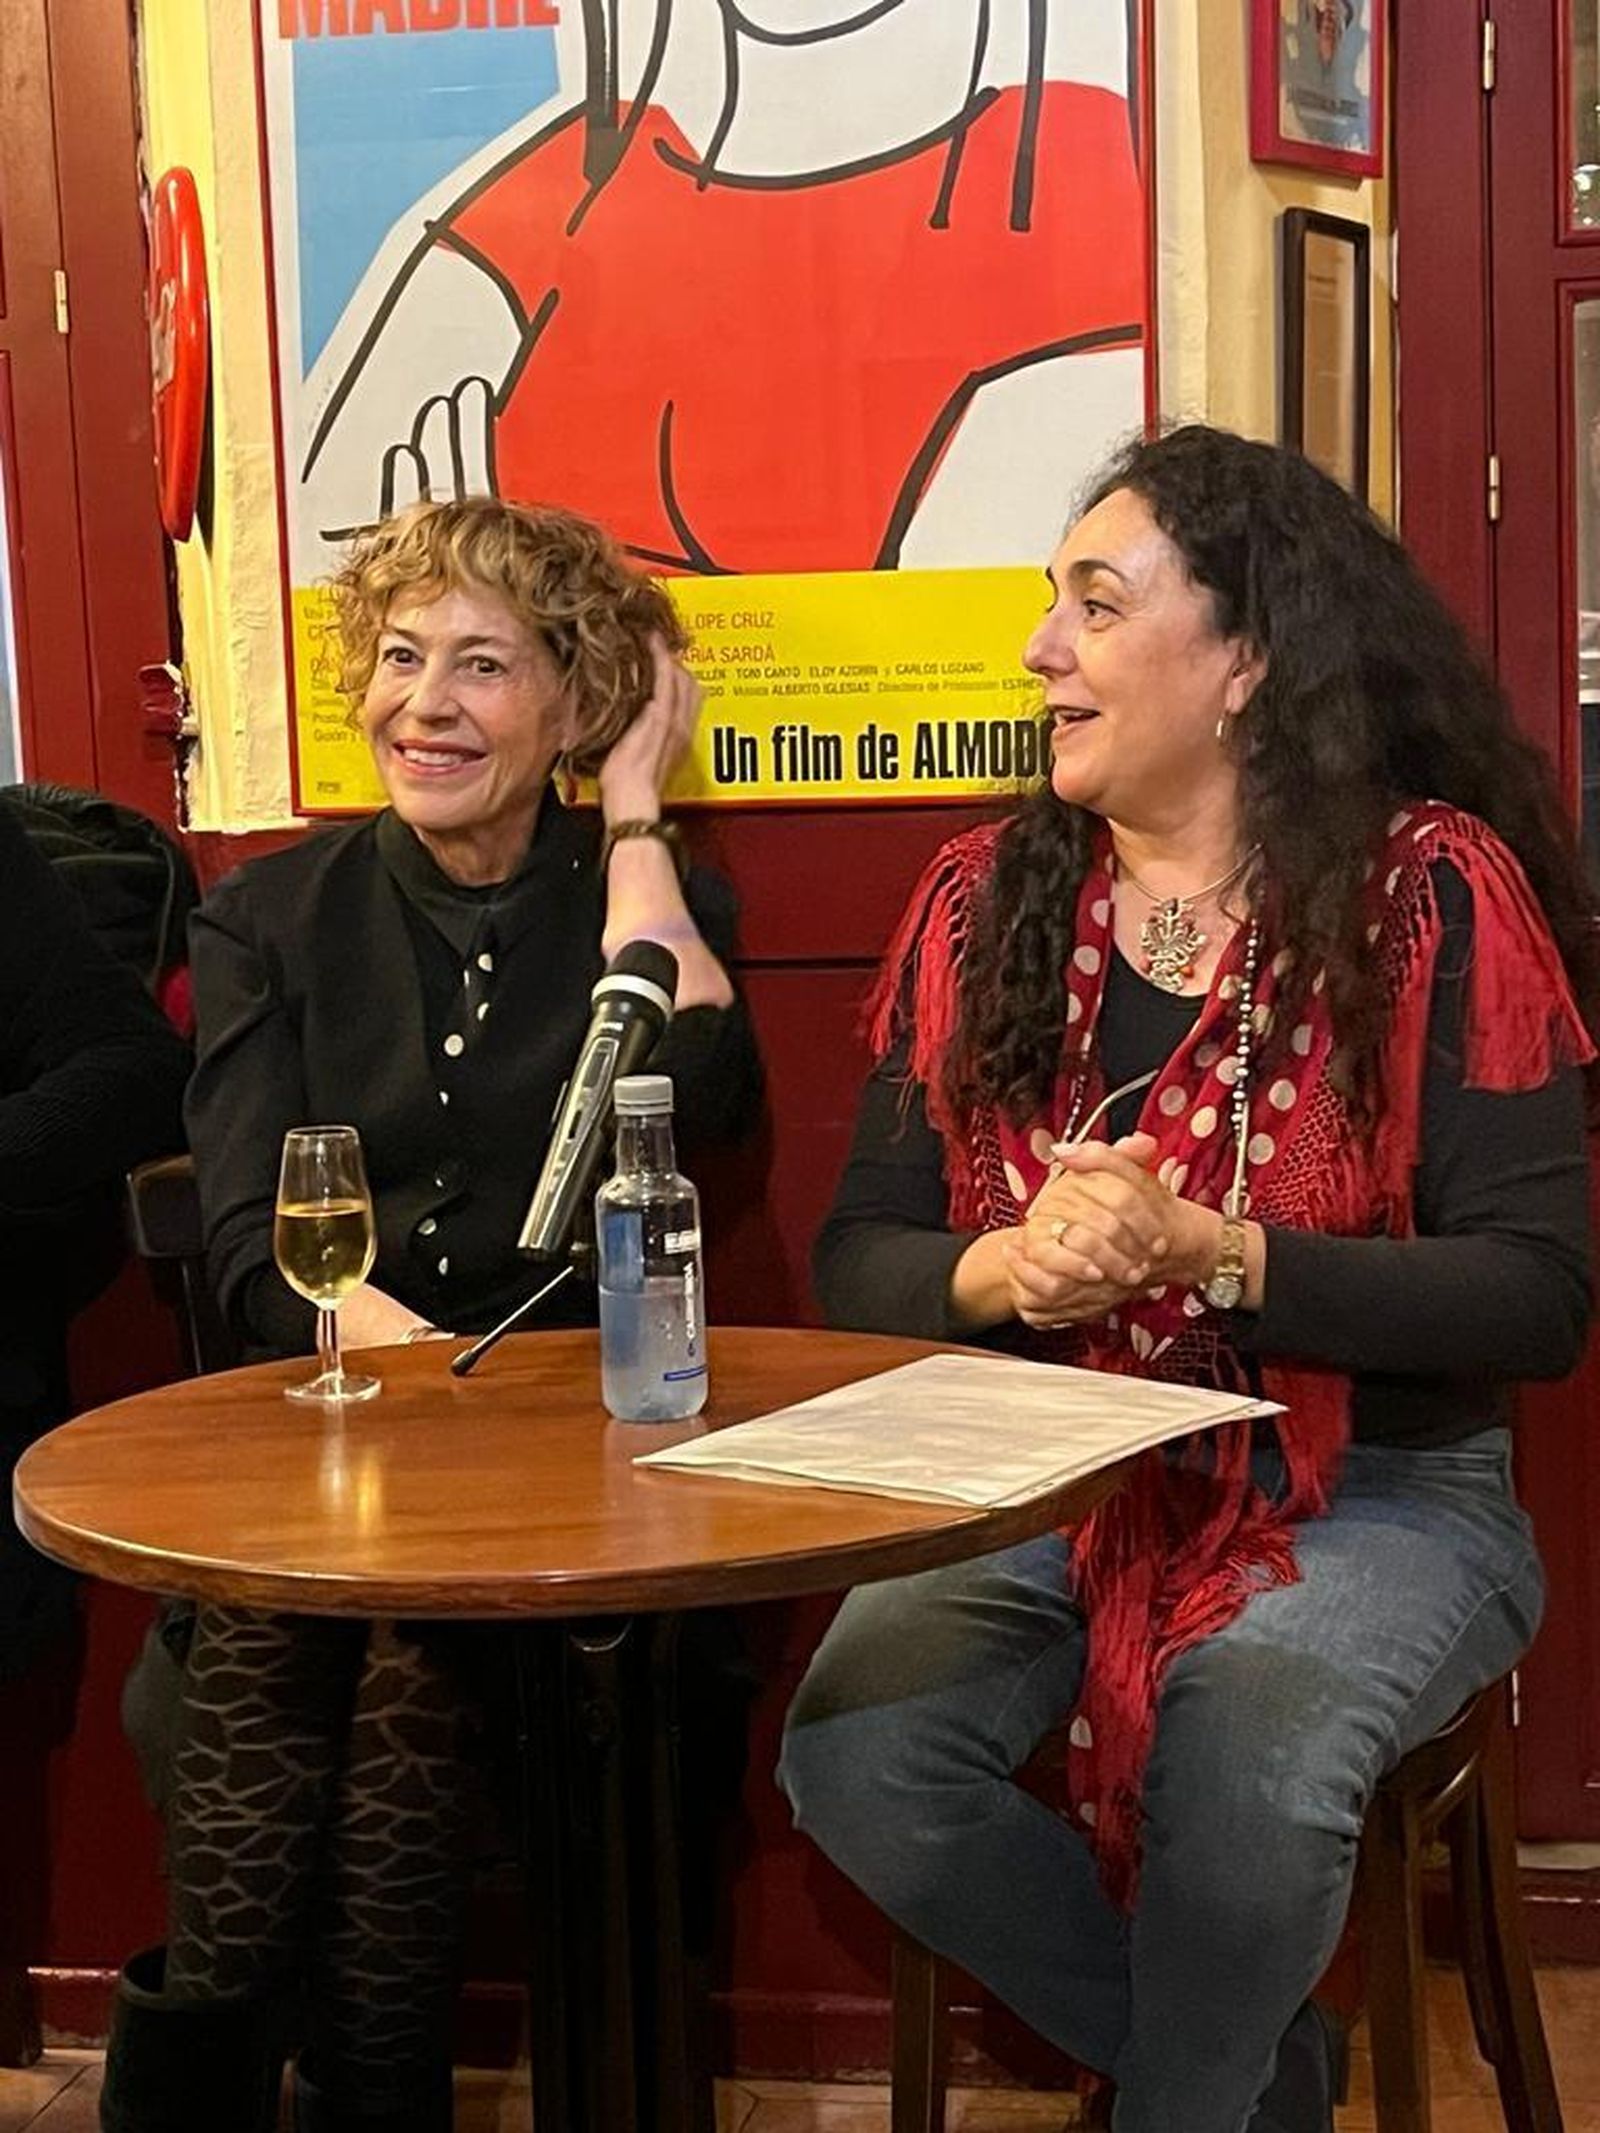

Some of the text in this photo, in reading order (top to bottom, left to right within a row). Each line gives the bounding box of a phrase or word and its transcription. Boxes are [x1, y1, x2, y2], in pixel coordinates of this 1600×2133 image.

[731, 611, 775, 630] CRUZ
[809, 665, 836, 678] ELOY
[895, 662, 938, 675] CARLOS
[941, 661, 985, 675] LOZANO
[772, 683, 821, 696] ALBERTO
[823, 682, 870, 694] IGLESIAS
[713, 726, 759, 784] Un
[772, 724, 842, 782] film
[857, 723, 899, 780] de
